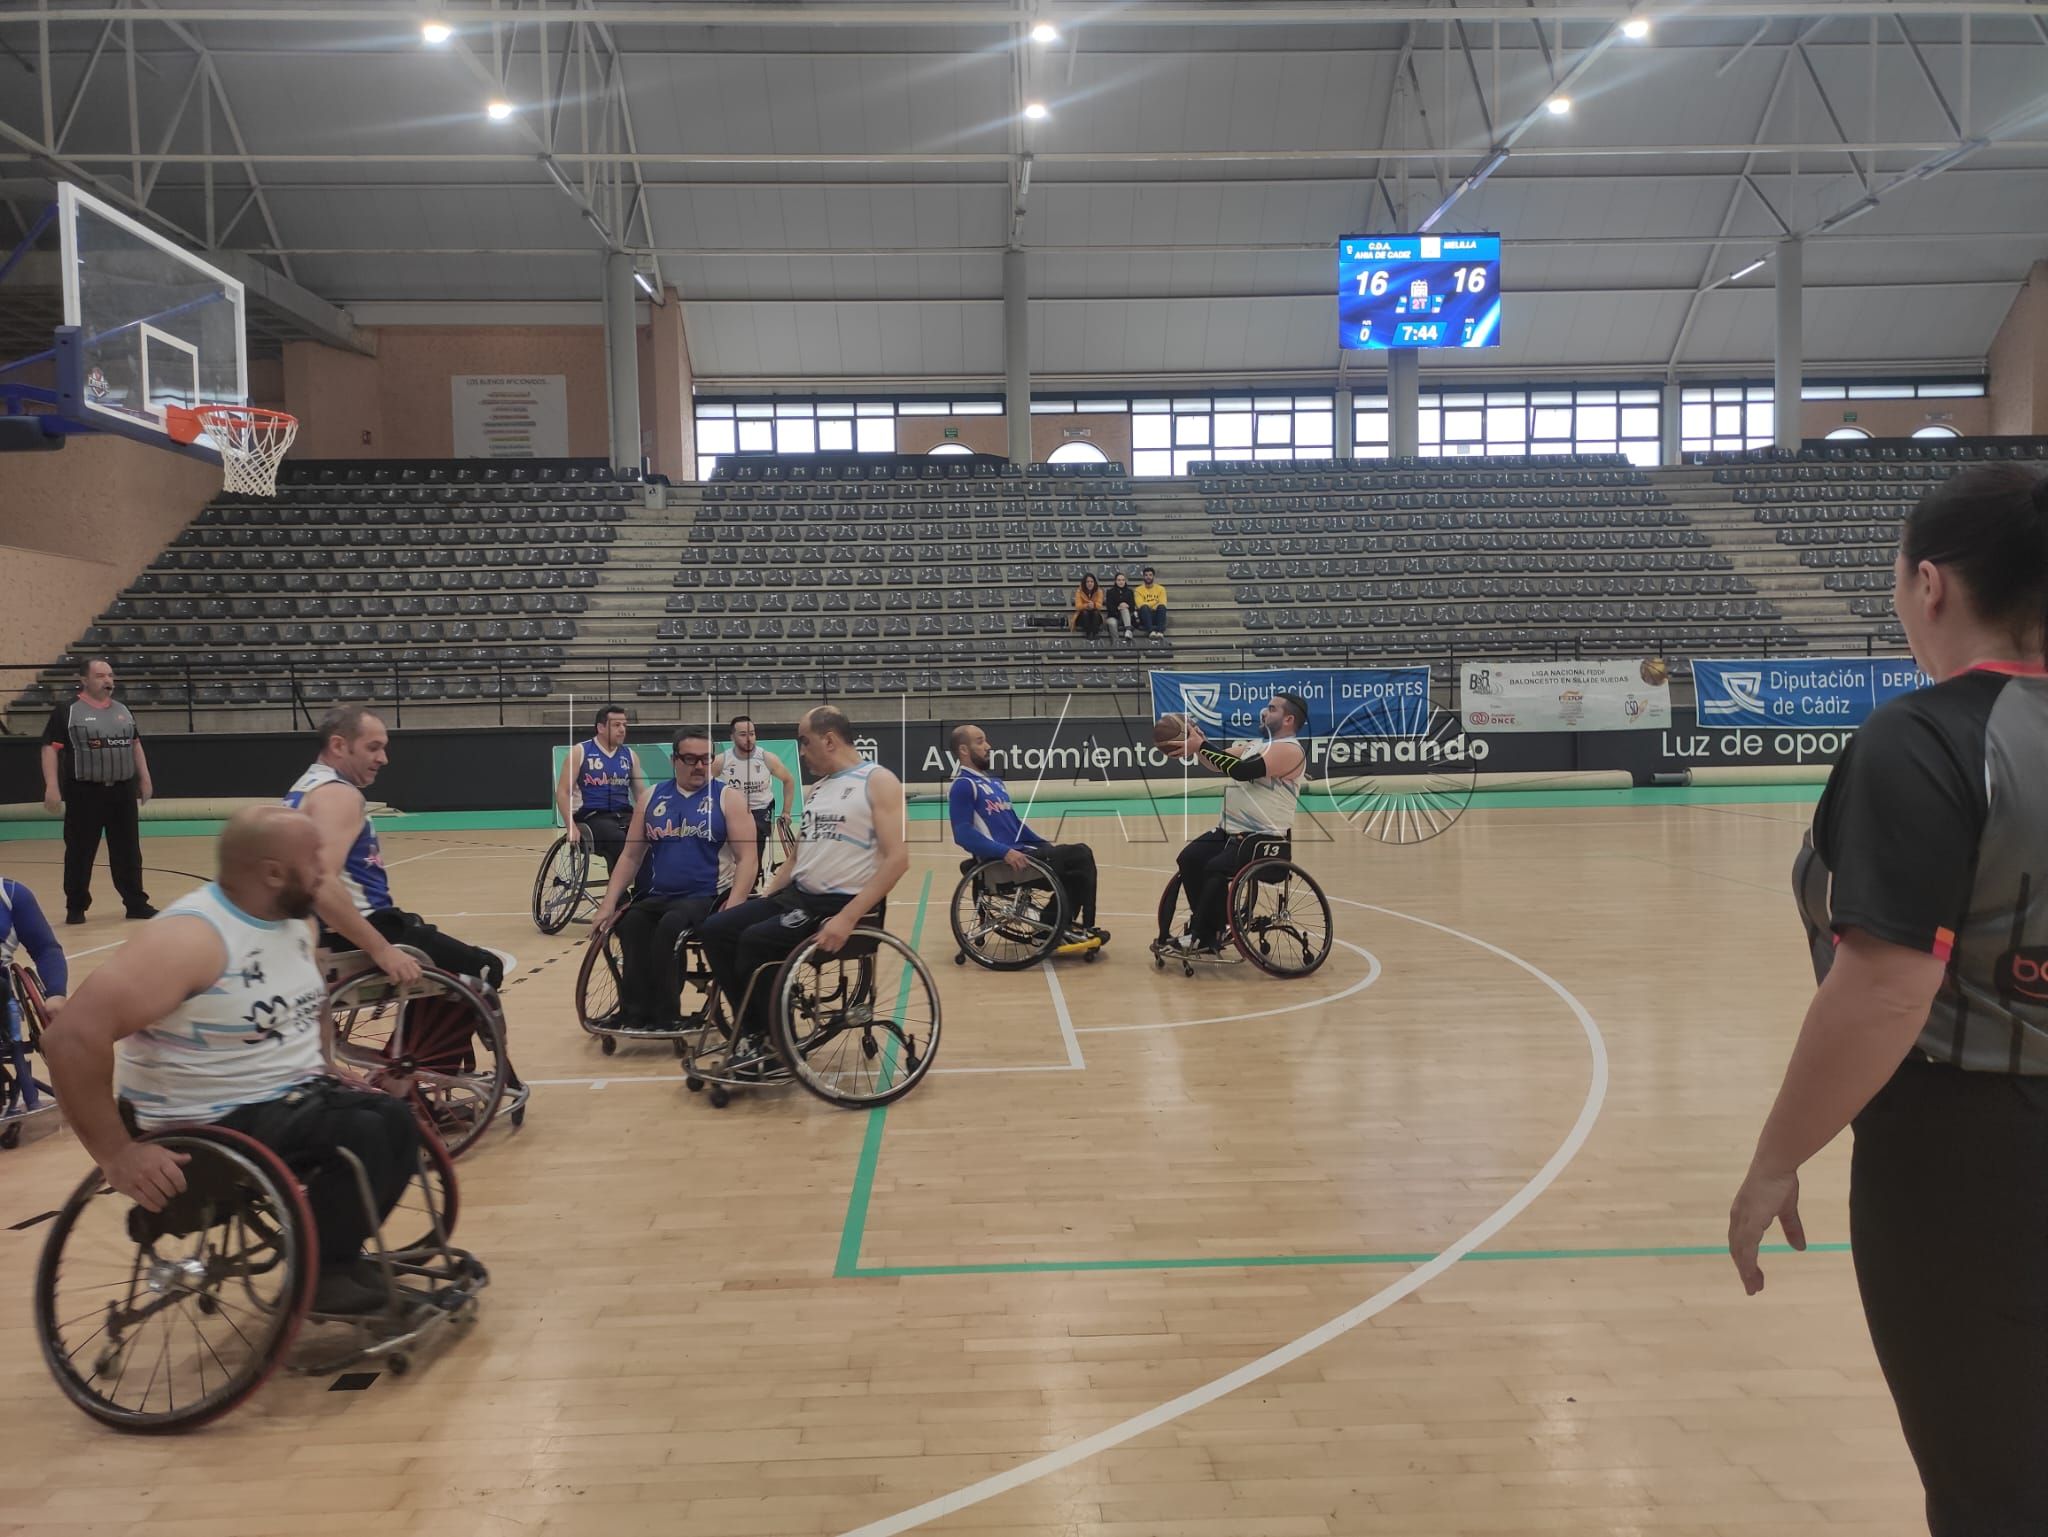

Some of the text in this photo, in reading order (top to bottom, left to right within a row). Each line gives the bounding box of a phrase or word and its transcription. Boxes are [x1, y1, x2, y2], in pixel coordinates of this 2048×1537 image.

[1356, 270, 1389, 296] 16
[1454, 267, 1487, 293] 16
[1359, 328, 1370, 342] 0
[1402, 325, 1438, 341] 7:44
[1341, 681, 1423, 699] DEPORTES
[1770, 670, 1866, 692] Diputación
[1772, 696, 1851, 714] de Cádiz
[1490, 717, 1516, 725] ONCE
[1311, 733, 1490, 764] Fernando
[1662, 730, 1710, 757] Luz
[1720, 728, 1764, 756] de
[587, 757, 604, 770] 16
[921, 742, 1169, 780] Ayntamiento
[652, 800, 667, 817] 6
[1263, 844, 1280, 857] 13
